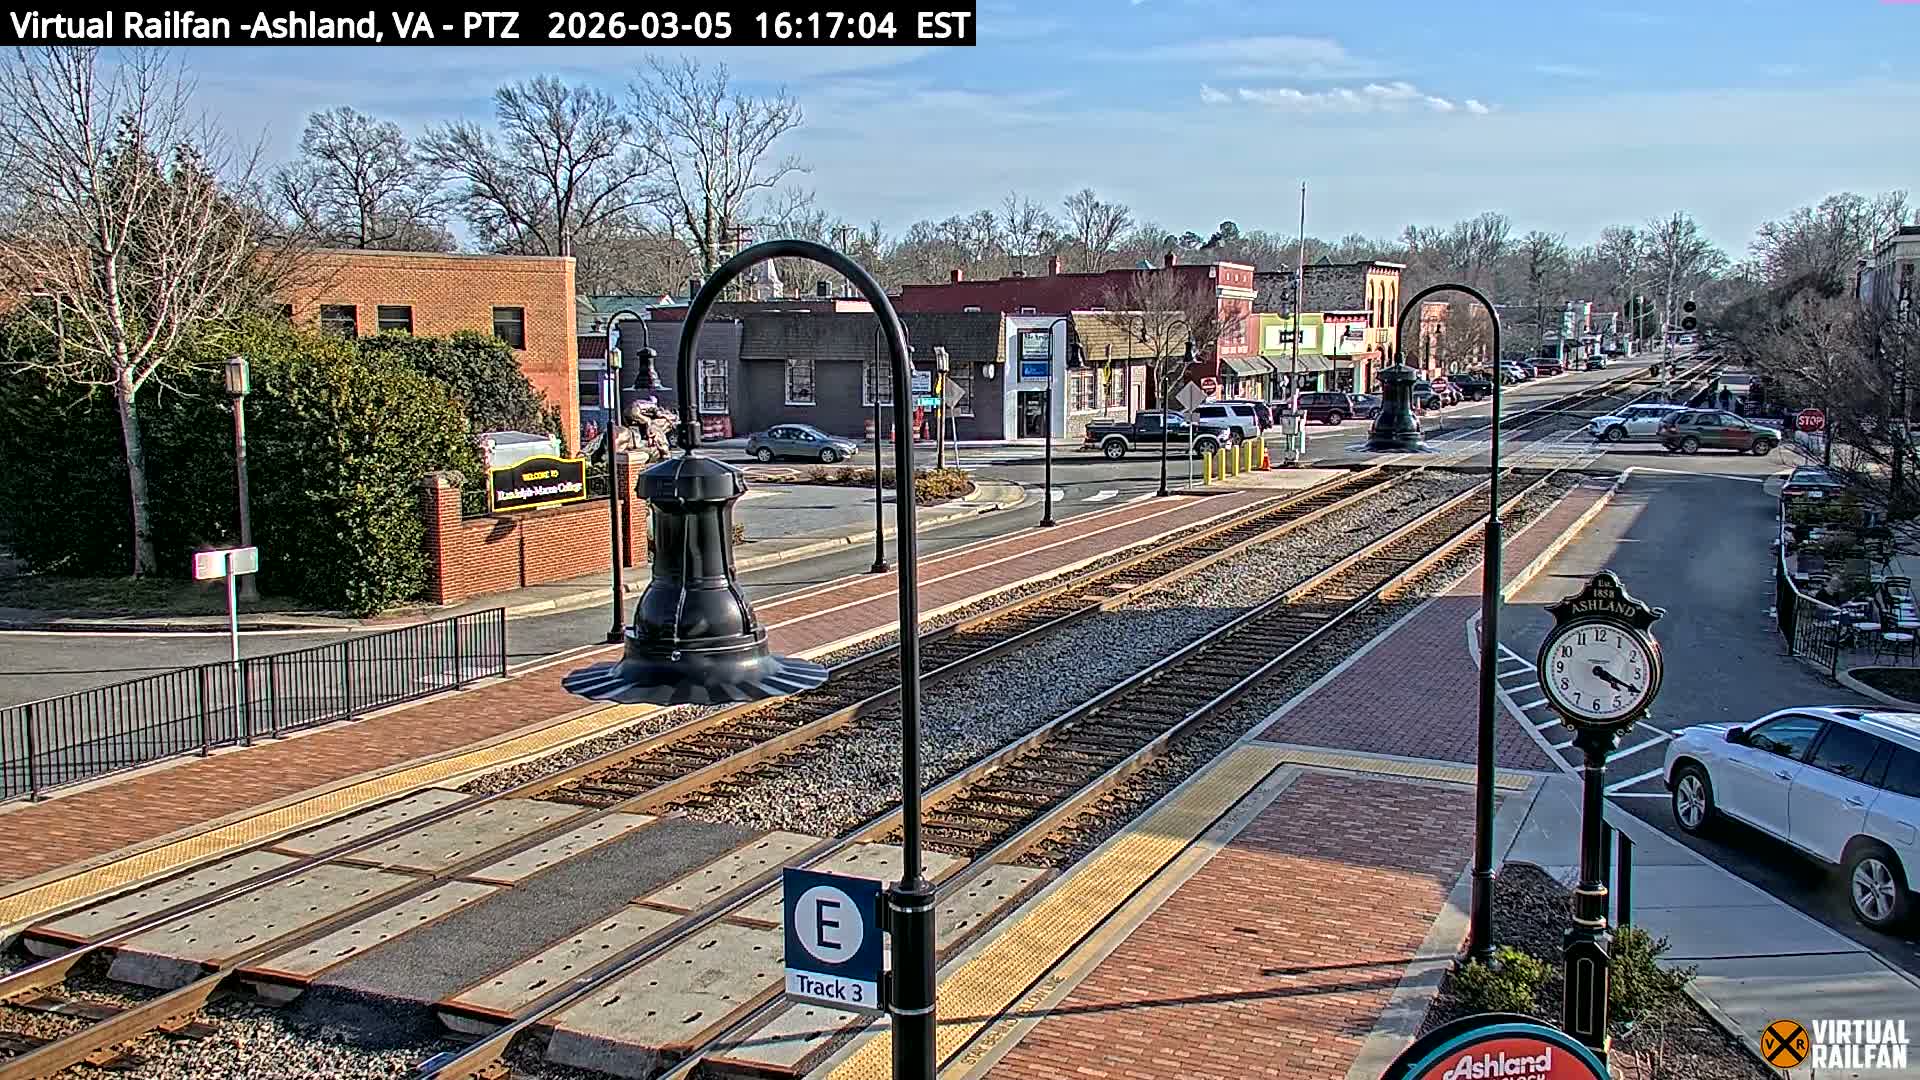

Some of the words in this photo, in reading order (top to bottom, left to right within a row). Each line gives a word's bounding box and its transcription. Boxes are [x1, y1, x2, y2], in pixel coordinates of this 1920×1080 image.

[1798, 416, 1823, 426] STOP
[1572, 600, 1636, 617] ASHLAND
[1577, 632, 1586, 646] 11
[1594, 629, 1607, 642] 12
[1616, 636, 1622, 648] 1
[1561, 645, 1573, 658] 10
[1629, 650, 1637, 663] 2
[1556, 660, 1564, 673] 9
[1633, 667, 1641, 680] 3
[1560, 677, 1569, 690] 8
[1573, 692, 1581, 704] 7
[1592, 698, 1600, 710] 6
[1613, 695, 1622, 708] 5
[816, 899, 842, 950] E
[796, 974, 846, 1000] Track
[851, 983, 863, 1002] 3
[1443, 1047, 1552, 1080] Ashland
